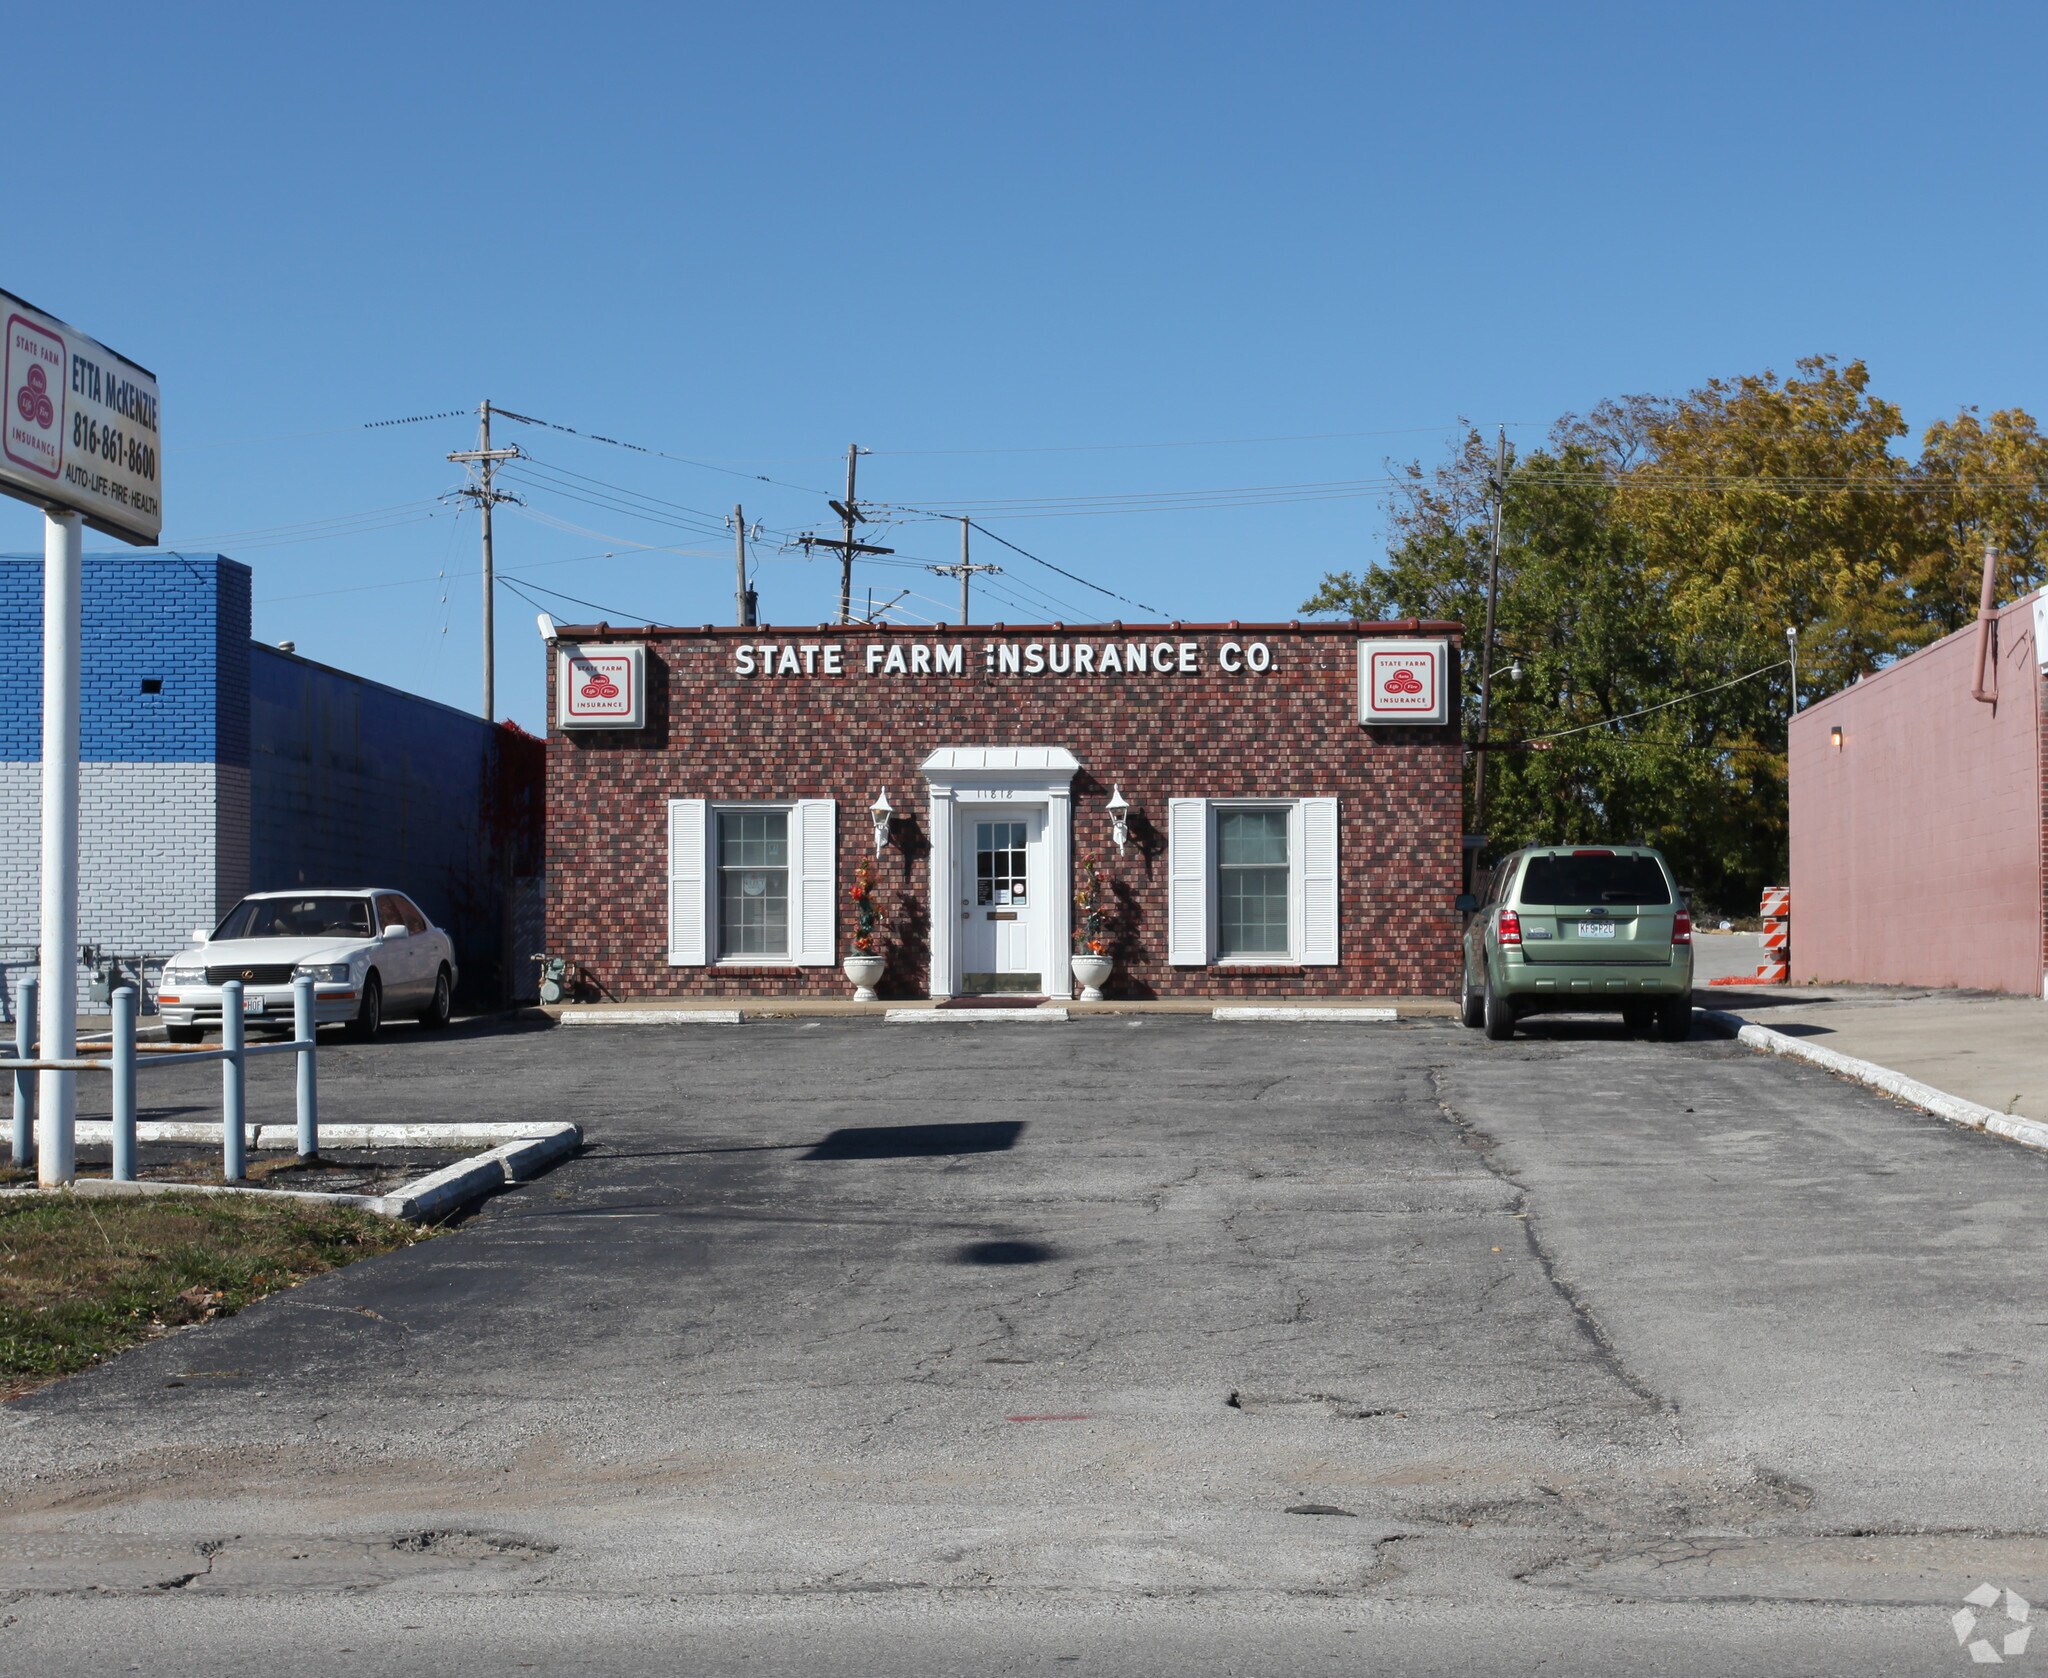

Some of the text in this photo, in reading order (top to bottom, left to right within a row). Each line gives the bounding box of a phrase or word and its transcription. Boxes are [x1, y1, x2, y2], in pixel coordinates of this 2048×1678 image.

[16, 335, 59, 366] STATE FARM
[72, 353, 157, 433] ETTA McKENZIE
[12, 427, 55, 457] INSURANCE
[73, 411, 156, 482] 816-861-8600
[735, 642, 1279, 675] STATE FARM INSURANCE CO.
[977, 789, 1013, 799] 11818
